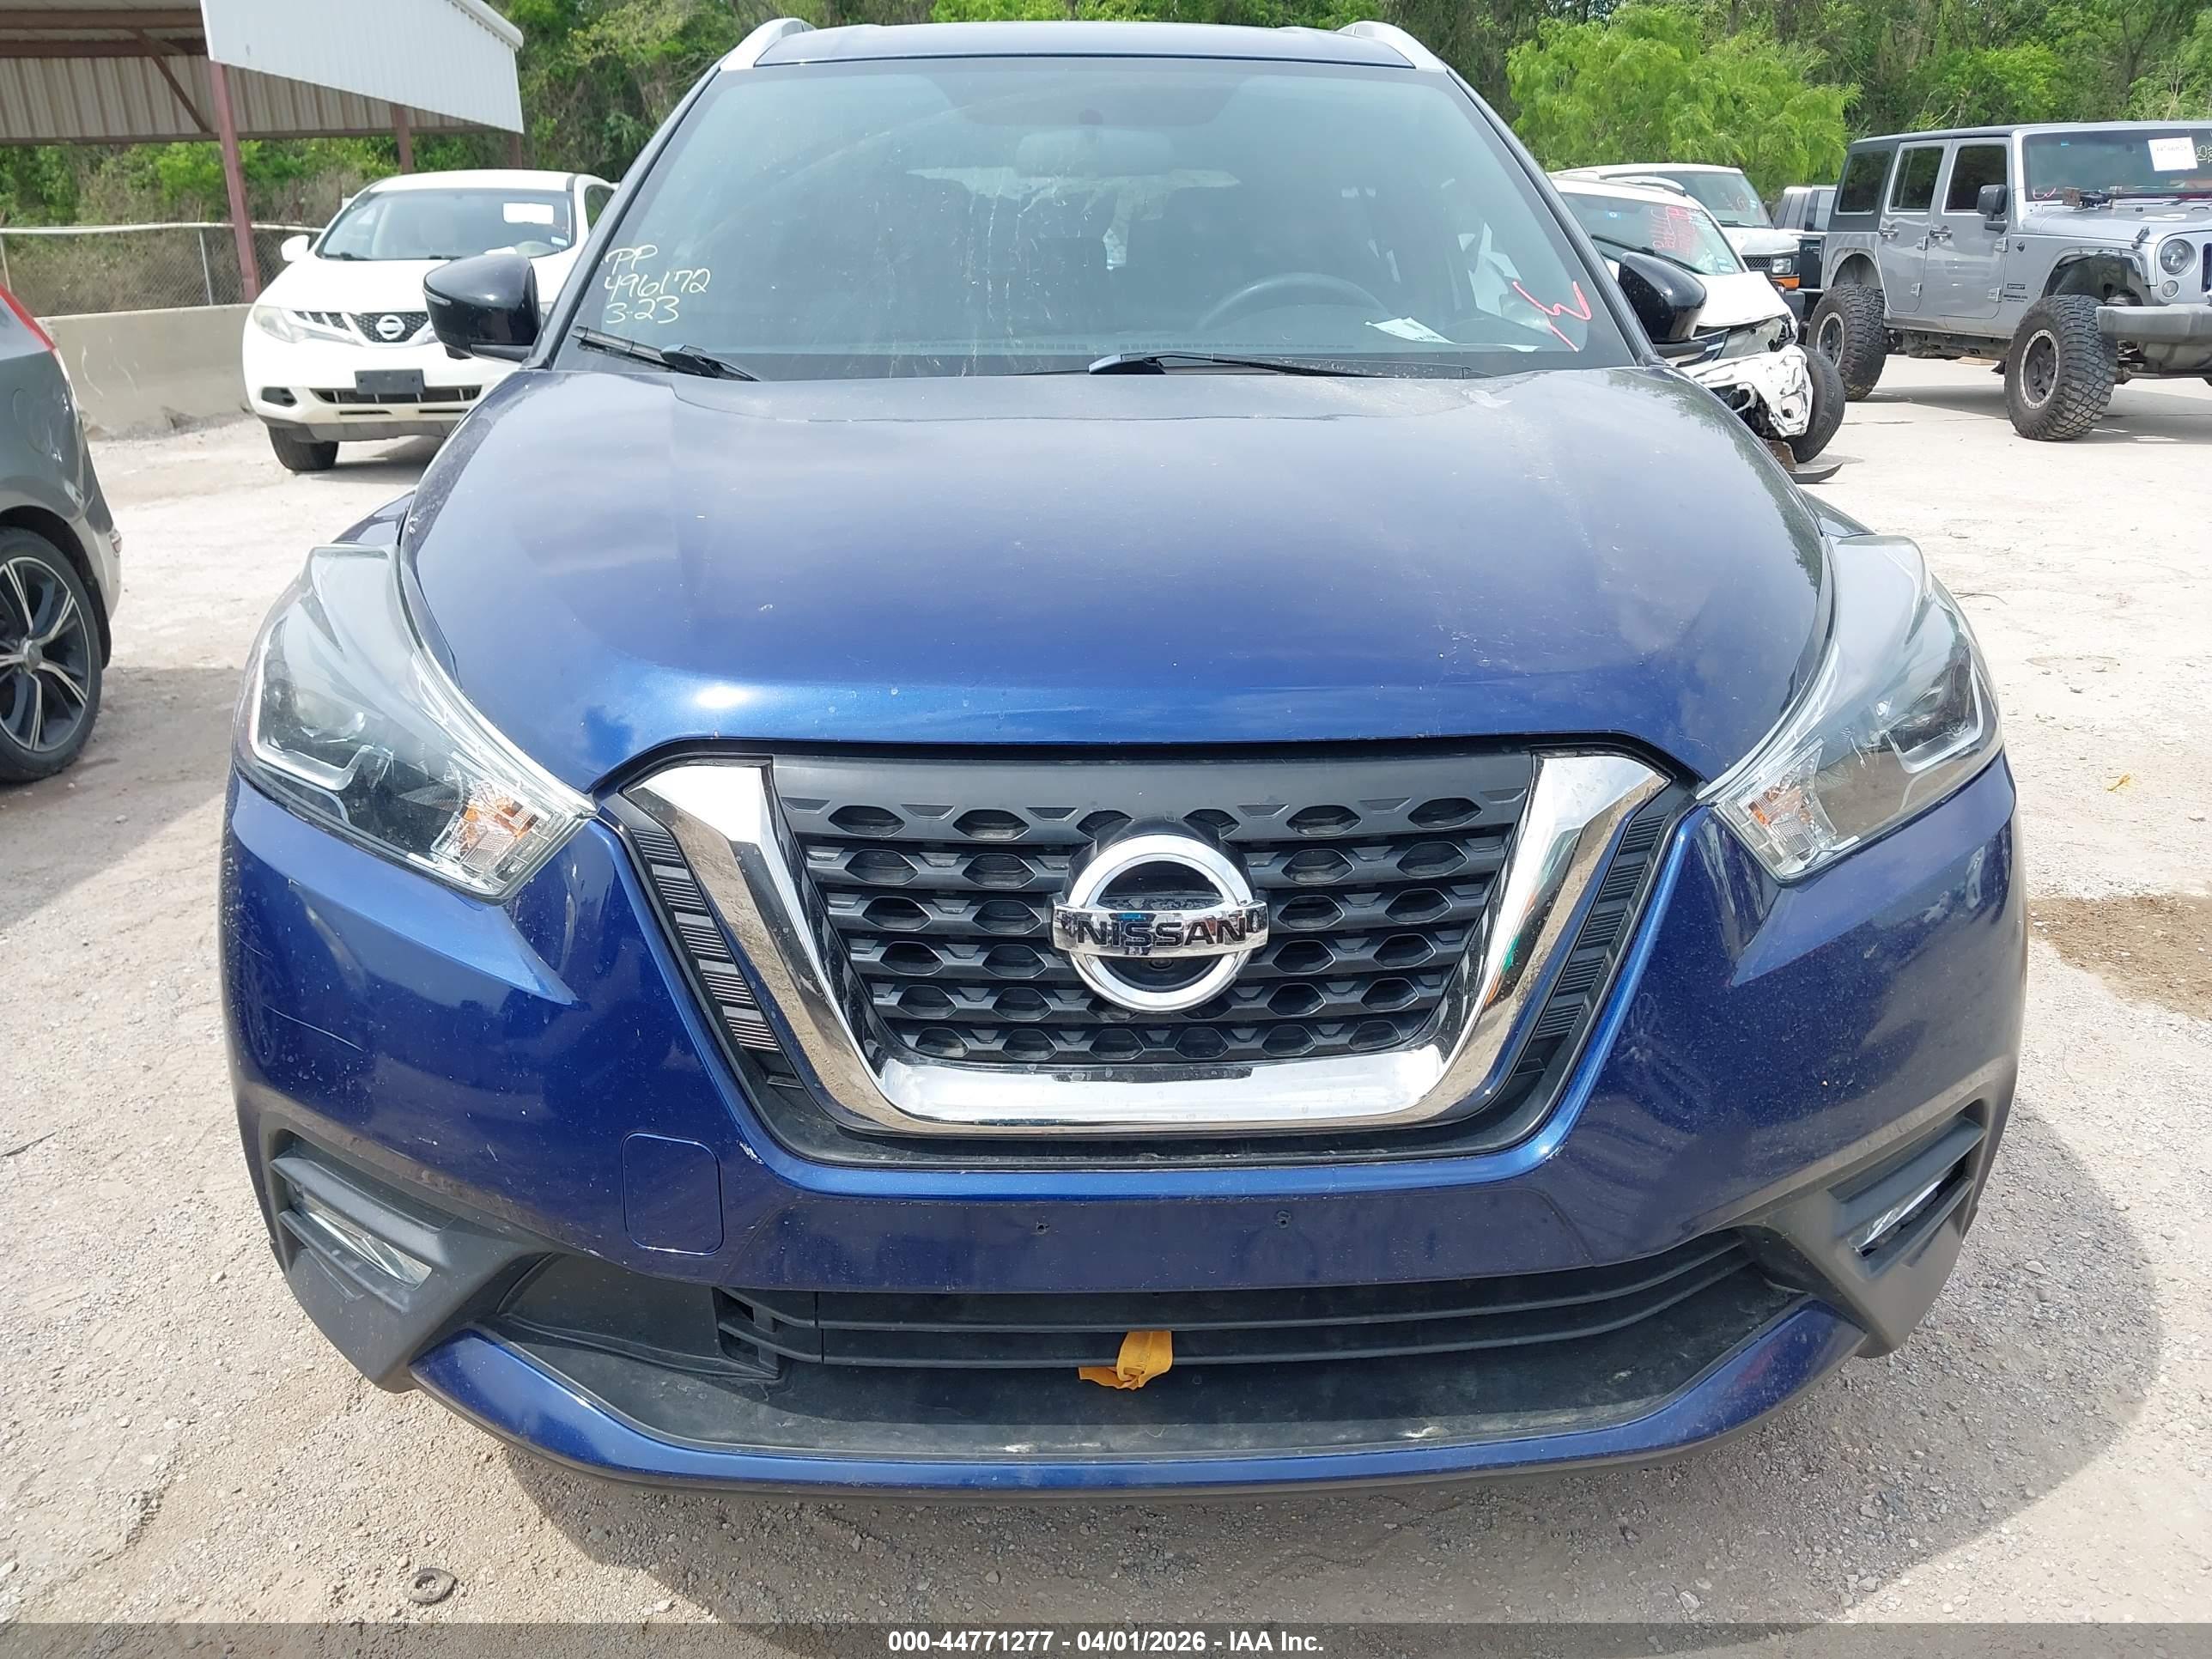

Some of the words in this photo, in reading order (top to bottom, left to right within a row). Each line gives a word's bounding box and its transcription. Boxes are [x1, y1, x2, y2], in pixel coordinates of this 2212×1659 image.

[604, 268, 711, 302] 496172
[605, 295, 680, 324] 3-23
[1077, 916, 1246, 948] NISSAN
